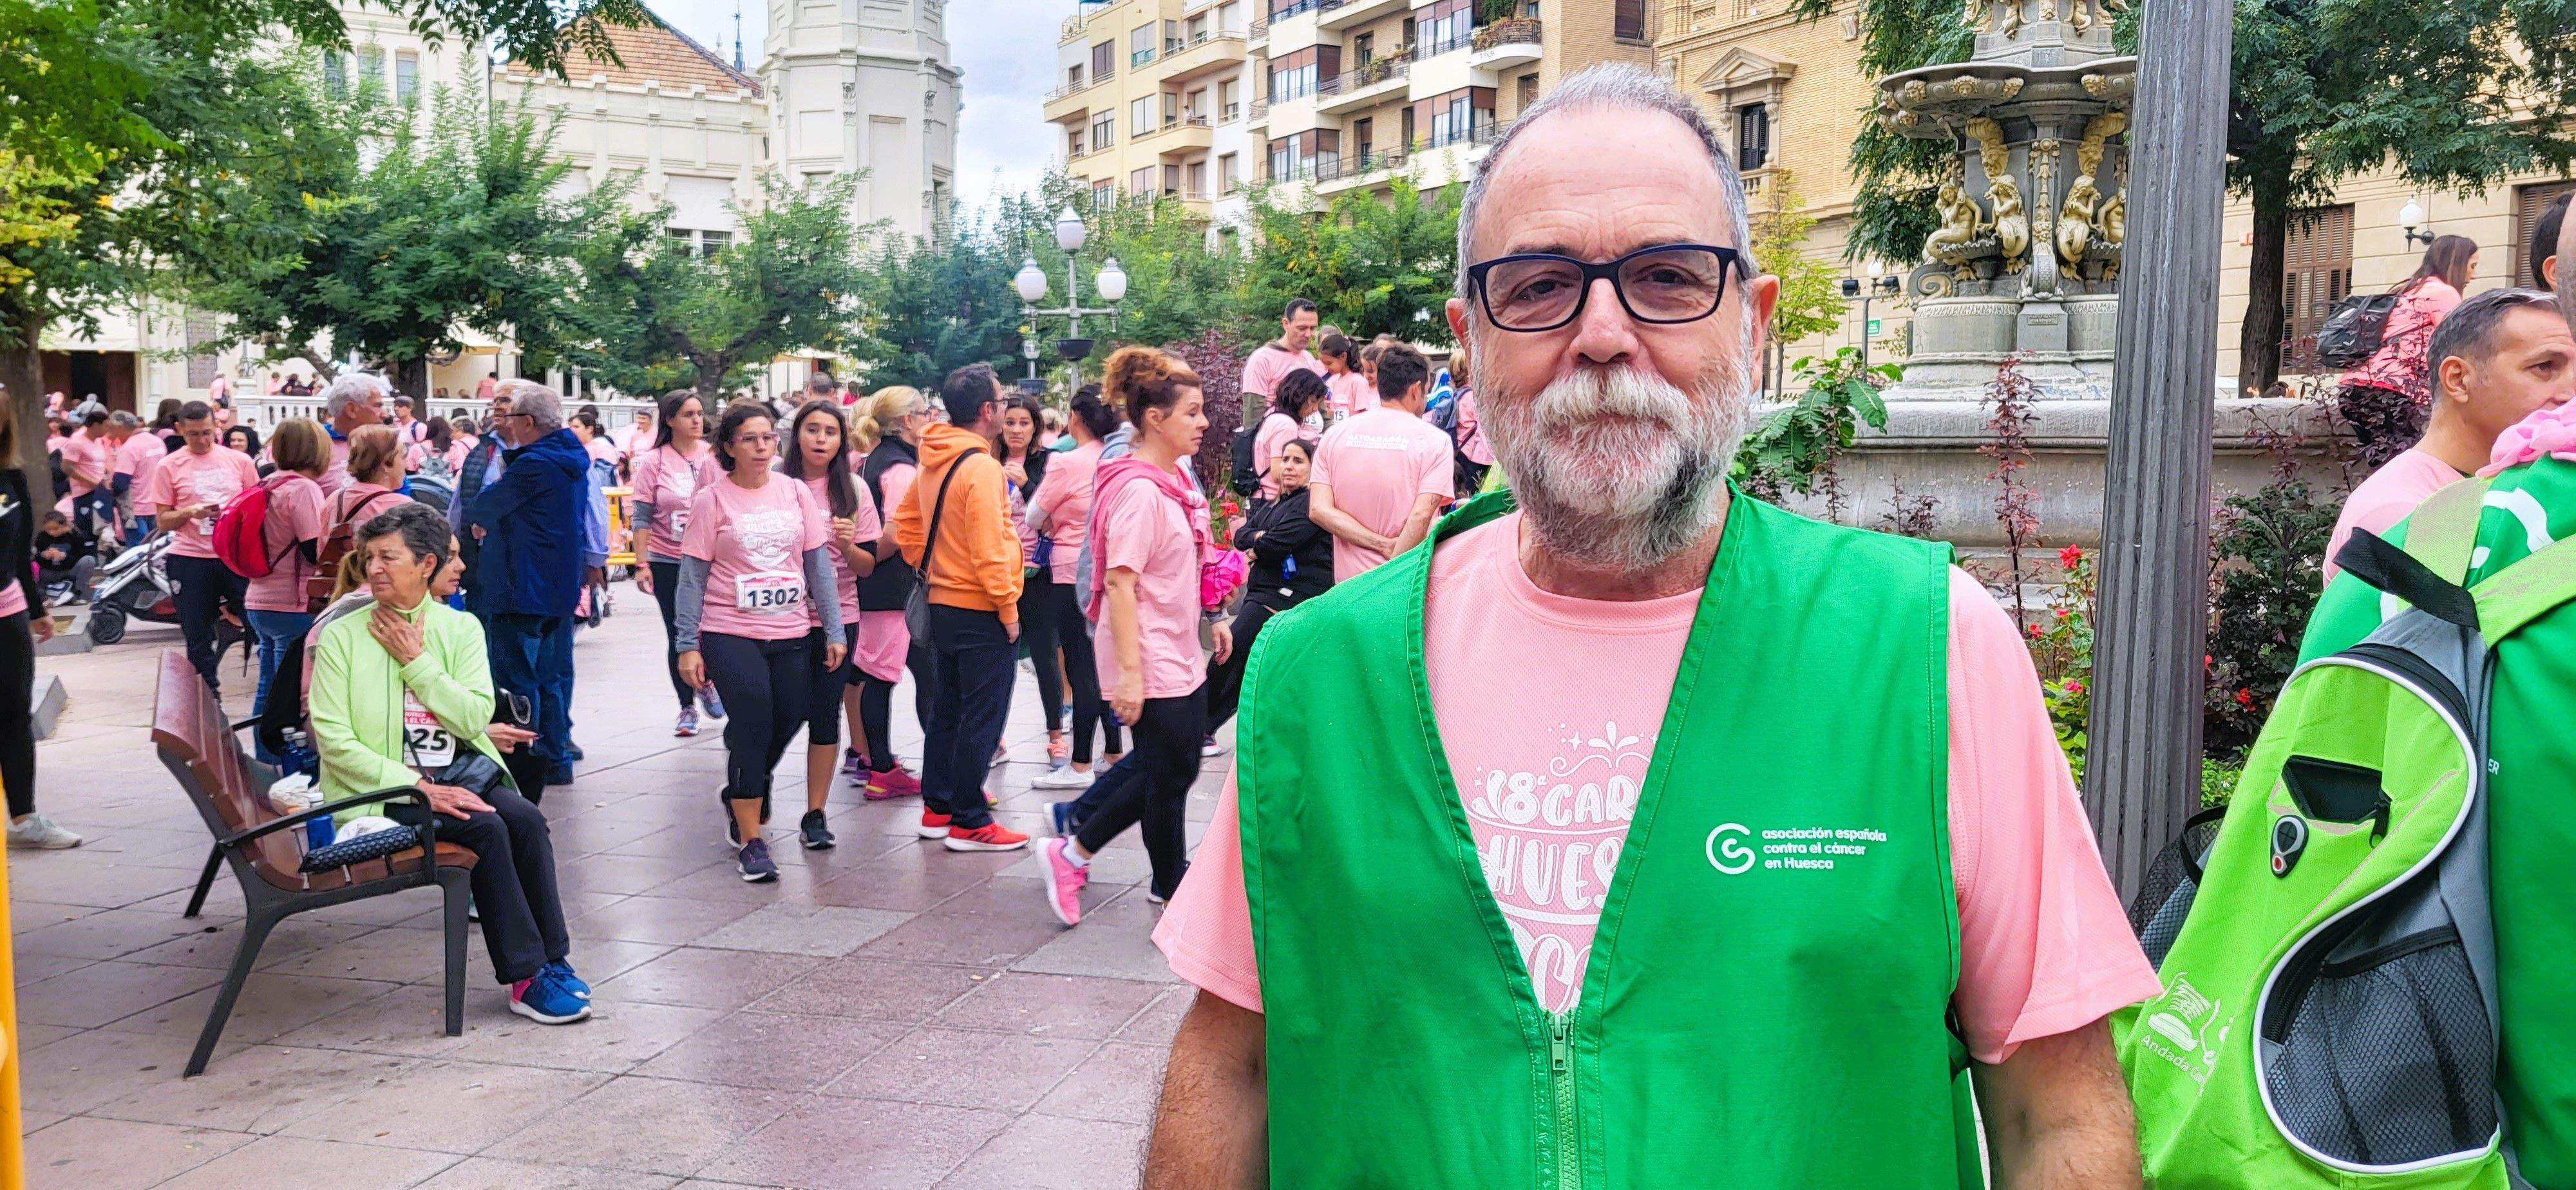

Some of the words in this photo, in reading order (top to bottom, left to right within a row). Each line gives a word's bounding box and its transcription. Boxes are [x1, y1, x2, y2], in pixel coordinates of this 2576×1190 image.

[1334, 410, 1344, 421] 15
[747, 587, 799, 607] 1302
[1761, 827, 1833, 840] asociación
[1835, 828, 1888, 842] española
[1763, 842, 1808, 855] contra
[1808, 842, 1823, 855] el
[1823, 842, 1866, 856] cáncer
[1764, 858, 1783, 869] en
[1783, 856, 1834, 869] Huesca
[2139, 1034, 2190, 1072] Andada
